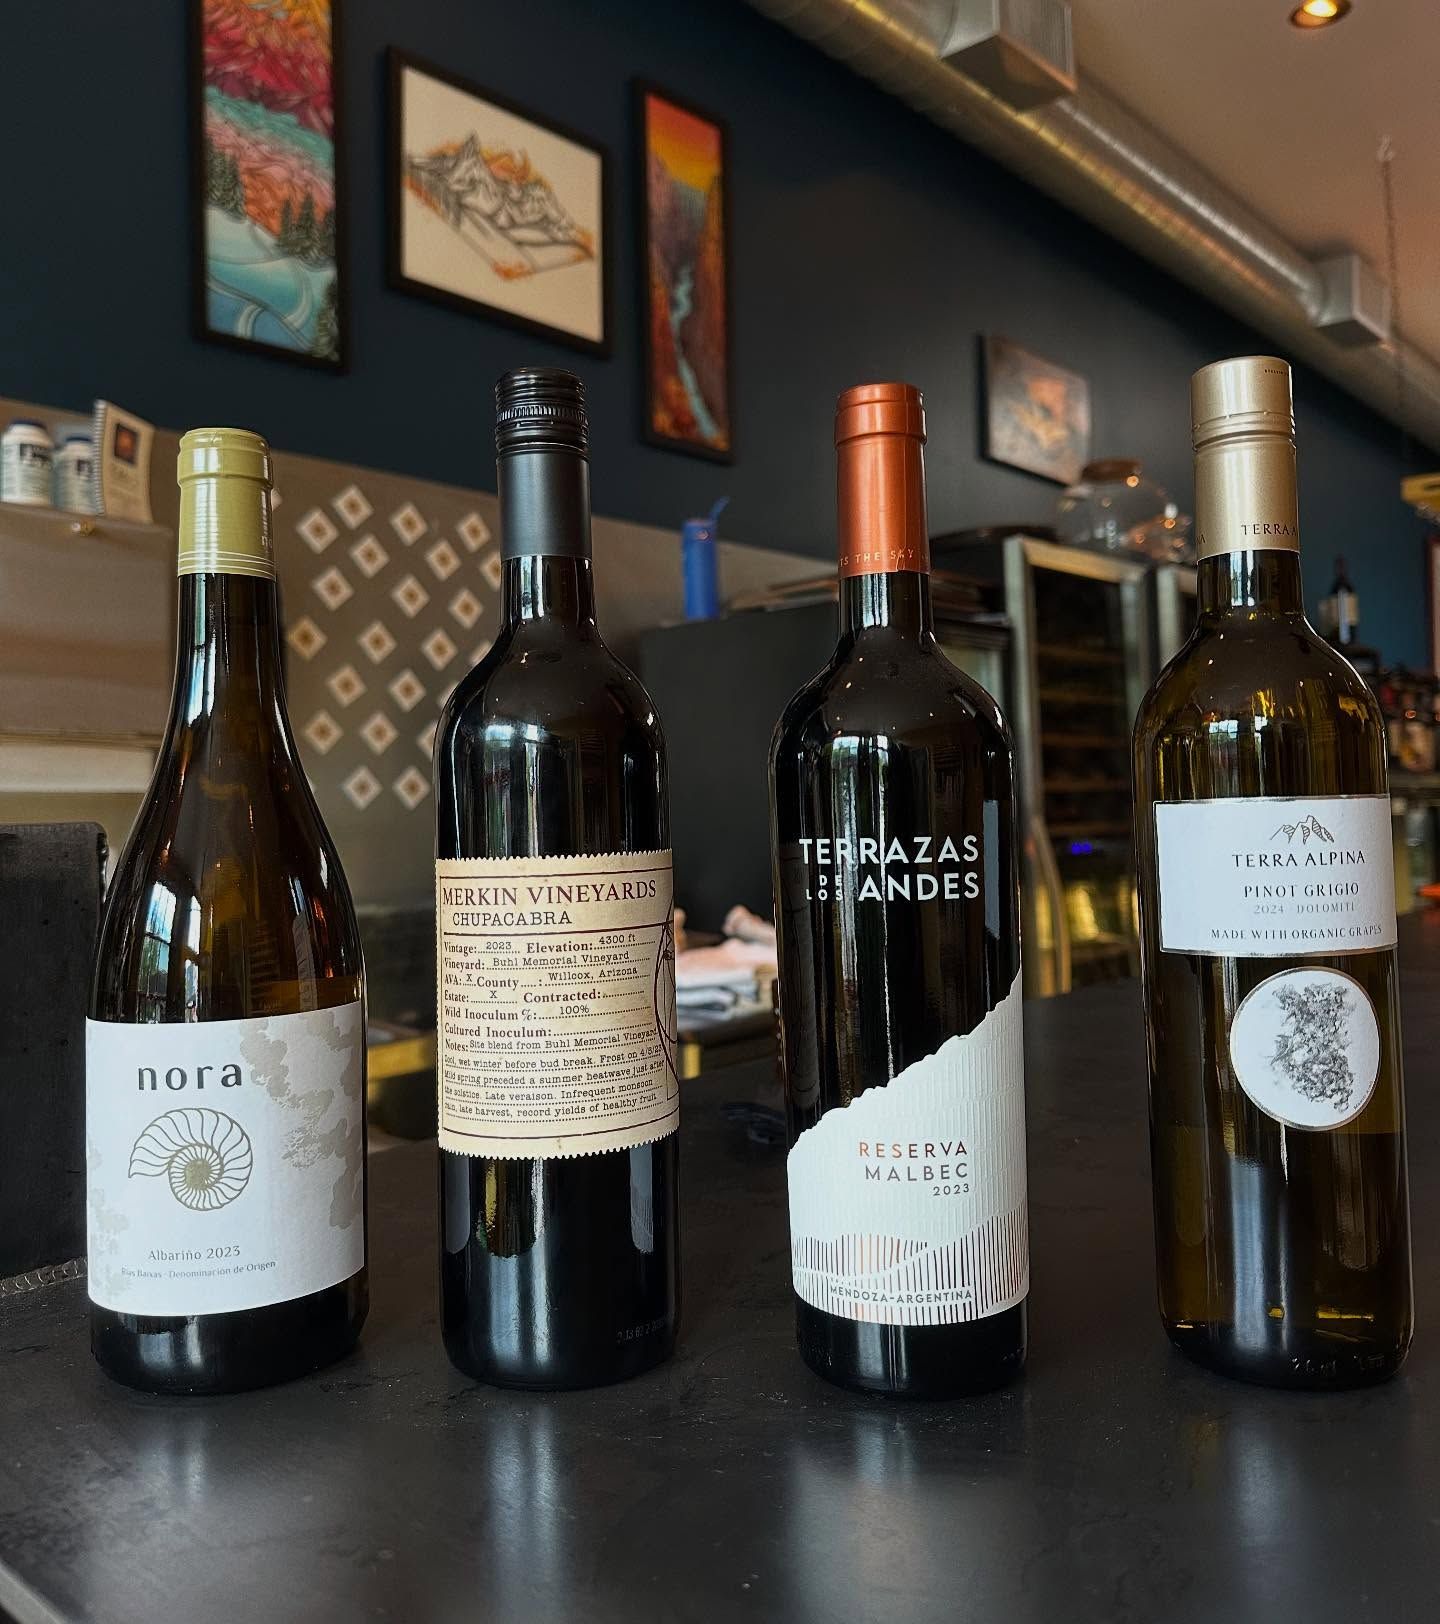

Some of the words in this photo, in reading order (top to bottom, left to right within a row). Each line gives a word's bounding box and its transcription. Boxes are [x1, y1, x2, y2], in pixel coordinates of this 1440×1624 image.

[1241, 523, 1289, 535] TERRA
[855, 552, 881, 564] THE
[798, 834, 979, 865] TERRAZAS
[1231, 853, 1298, 867] TERRA
[1304, 850, 1366, 866] ALPINA
[819, 874, 842, 887] DE
[857, 871, 980, 901] ANDES
[443, 886, 517, 905] MERKIN
[527, 879, 657, 905] VINEYARDS
[805, 888, 843, 901] LOS
[1244, 884, 1298, 898] PINOT
[1304, 882, 1360, 897] GRIGIO
[452, 910, 572, 926] CHUPACABRA
[1210, 928, 1246, 940] MADE
[1251, 928, 1287, 940] WITH
[1291, 927, 1346, 940] ORGANIC
[1349, 924, 1382, 937] GRAPES
[444, 941, 477, 957] Vintage:
[486, 941, 512, 950] 2023
[526, 940, 593, 954] Elevation:
[598, 934, 625, 945] 4300
[628, 933, 636, 943] ft
[444, 957, 485, 972] Vineyard:
[493, 957, 518, 966] Buhl
[522, 955, 577, 966] Memorial
[581, 951, 630, 964] Vineyard
[477, 976, 519, 991] County
[548, 971, 594, 981] Willcox,
[598, 967, 638, 978] Arizona
[444, 989, 469, 1002] Estate:
[490, 990, 498, 998] X
[523, 988, 601, 1004] Contracted:
[444, 1005, 461, 1018] Wild
[465, 1008, 518, 1020] Inoculum
[560, 1004, 590, 1015] 100%
[444, 1022, 481, 1037] Cultured
[486, 1027, 552, 1038] Inoculum:
[445, 1038, 469, 1052] Notes:
[470, 1039, 485, 1049] Site
[488, 1040, 513, 1050] blend
[516, 1041, 541, 1050] from
[545, 1039, 570, 1048] Buhl
[574, 1034, 621, 1047] Memorial
[623, 1028, 658, 1041] Vineyard
[458, 1057, 471, 1067] wet
[473, 1059, 502, 1068] winter
[505, 1060, 537, 1069] before
[540, 1058, 559, 1068] bud
[563, 1056, 596, 1067] break.
[600, 1054, 625, 1064] Frost
[627, 1051, 638, 1059] on
[138, 1063, 243, 1091] nora
[457, 1073, 481, 1084] spring
[484, 1076, 525, 1086] preceded
[539, 1075, 583, 1084] summer
[586, 1068, 631, 1081] heatwave
[632, 1064, 648, 1075] just
[649, 1060, 665, 1070] after
[485, 1091, 506, 1101] Late
[509, 1091, 557, 1101] veraison.
[561, 1085, 616, 1099] Infrequent
[618, 1079, 653, 1092] monsoon
[459, 1104, 473, 1114] late
[475, 1106, 513, 1118] harvest,
[517, 1106, 551, 1117] record
[554, 1105, 586, 1117] yields
[589, 1102, 600, 1112] of
[602, 1096, 637, 1111] healthy
[639, 1092, 657, 1104] fruit
[859, 1140, 968, 1159] RESERVA
[865, 1162, 968, 1182] MALBEC
[933, 1183, 970, 1197] 2023
[148, 1249, 202, 1261] Albariño
[206, 1245, 241, 1259] 2023
[233, 1264, 244, 1274] de
[246, 1260, 276, 1273] Origen
[830, 1285, 973, 1304] MENDOZA-ARGENTINA
